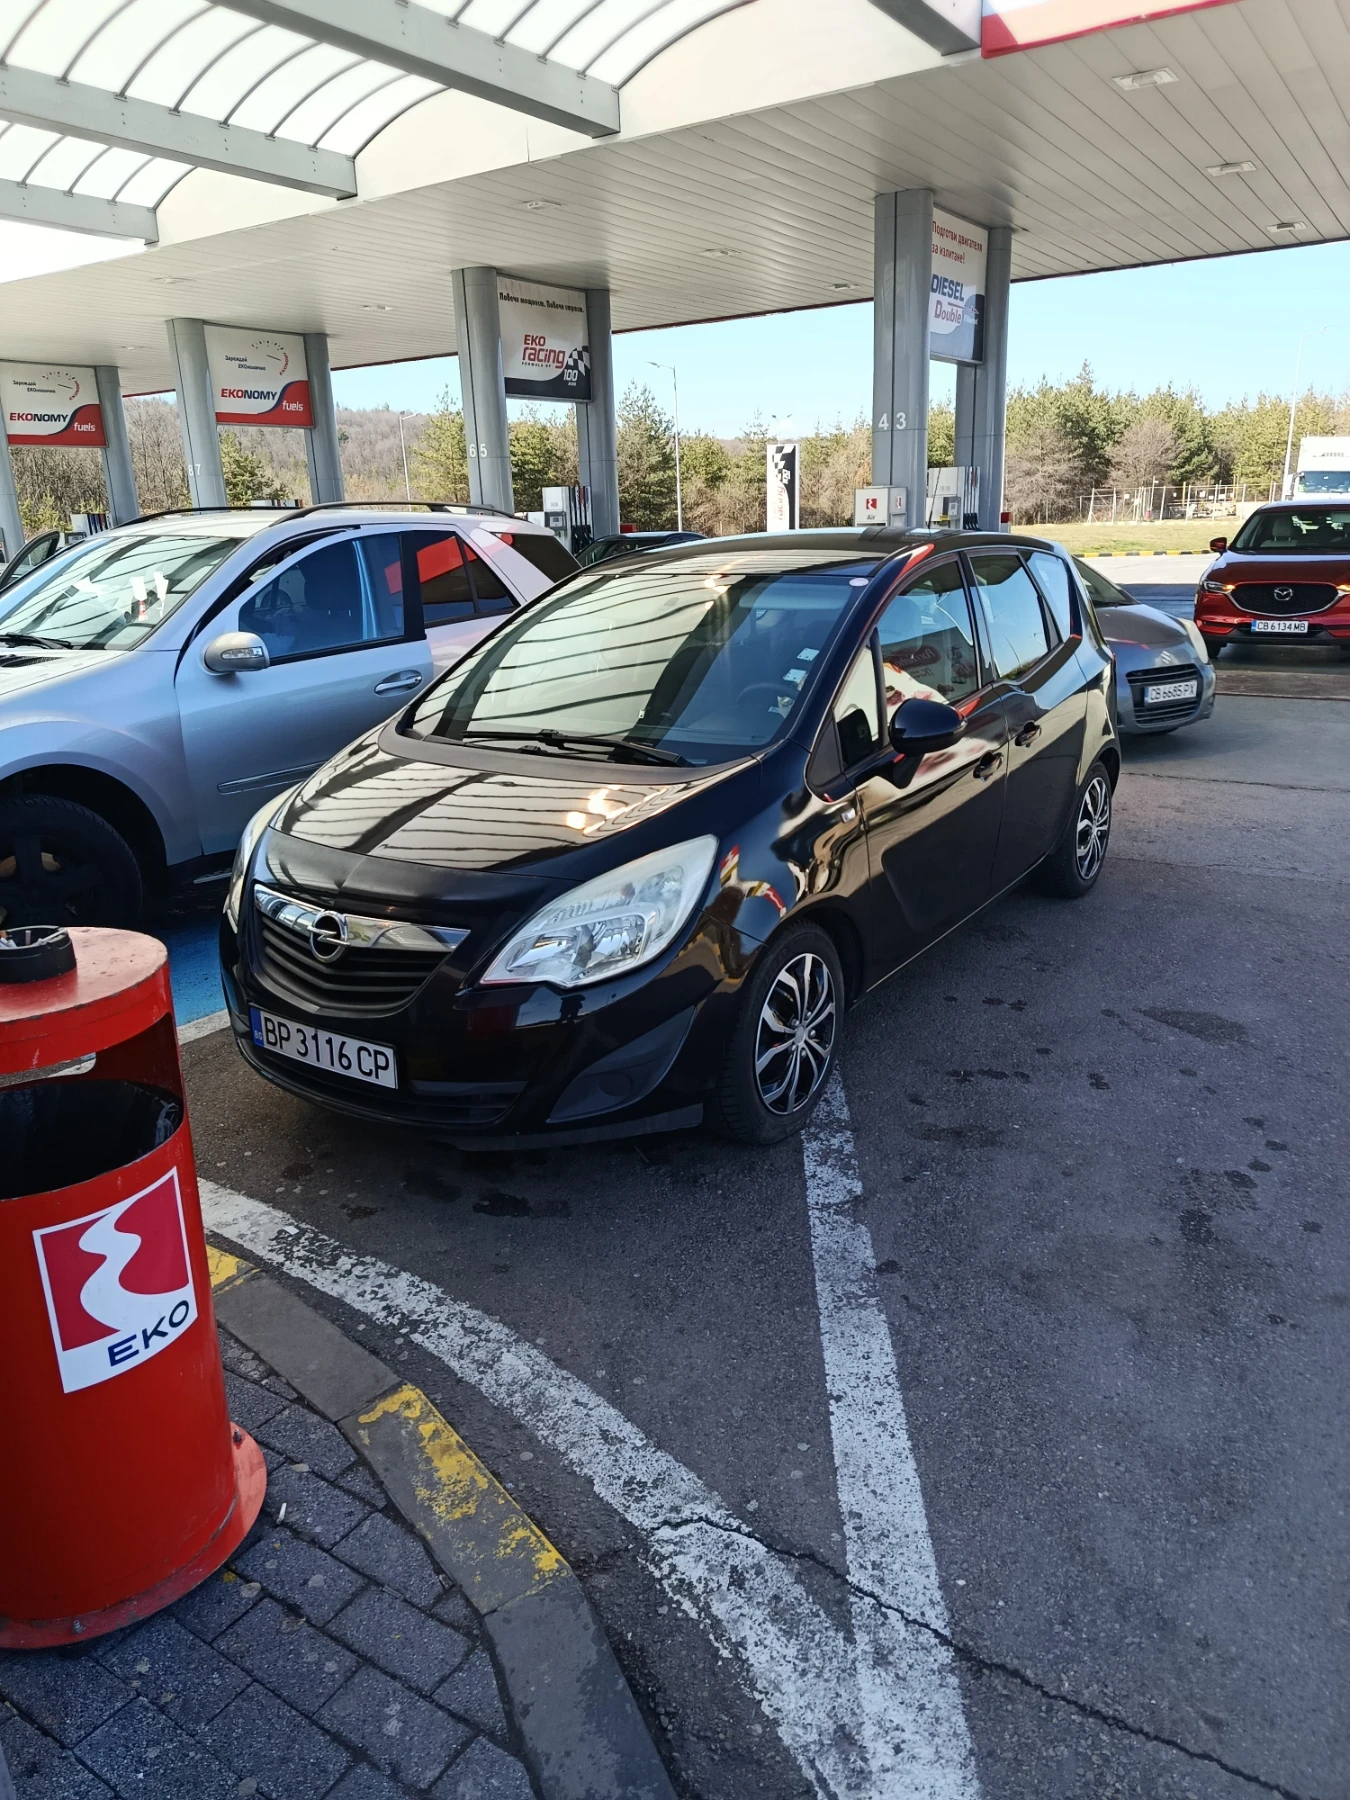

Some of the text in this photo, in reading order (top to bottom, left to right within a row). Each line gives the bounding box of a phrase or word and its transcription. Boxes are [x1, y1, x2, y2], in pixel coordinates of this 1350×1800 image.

[931, 273, 964, 301] DIESEL
[934, 299, 961, 324] Double
[523, 334, 546, 346] EKO
[522, 346, 566, 369] racing
[563, 369, 578, 381] 100
[221, 388, 277, 400] EKONOMY
[282, 400, 303, 411] fuels
[9, 412, 68, 422] EKONOMY
[74, 422, 96, 431] fuels
[253, 1029, 263, 1041] BG
[107, 1299, 190, 1367] EKO
